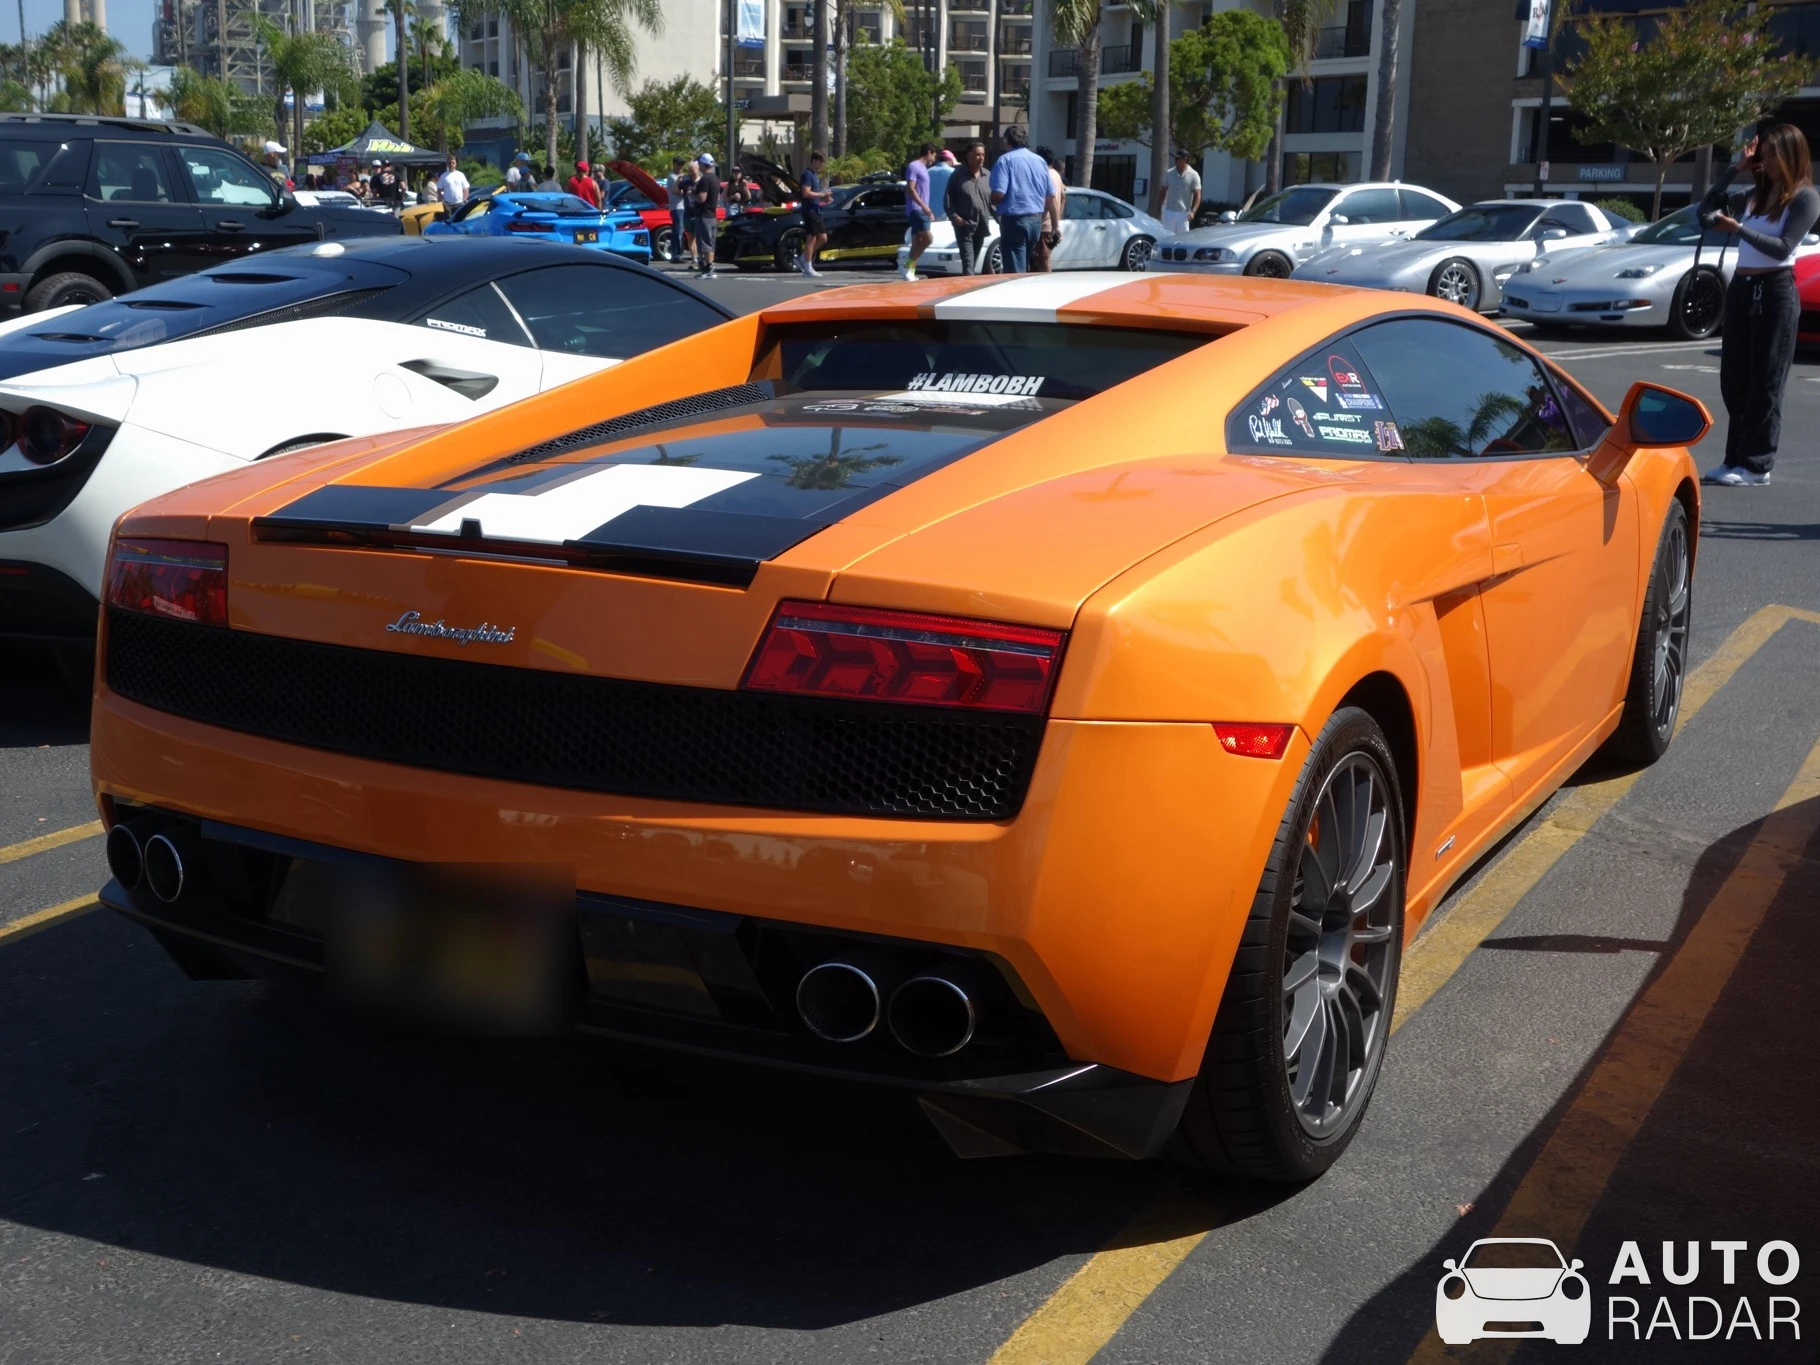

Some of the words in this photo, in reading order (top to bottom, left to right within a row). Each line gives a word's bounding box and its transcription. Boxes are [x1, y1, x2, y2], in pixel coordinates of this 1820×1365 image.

[1580, 167, 1621, 178] PARKING
[907, 372, 1045, 395] #LAMBOBH
[1318, 425, 1372, 442] PROMAX
[385, 610, 516, 646] Lamborghini
